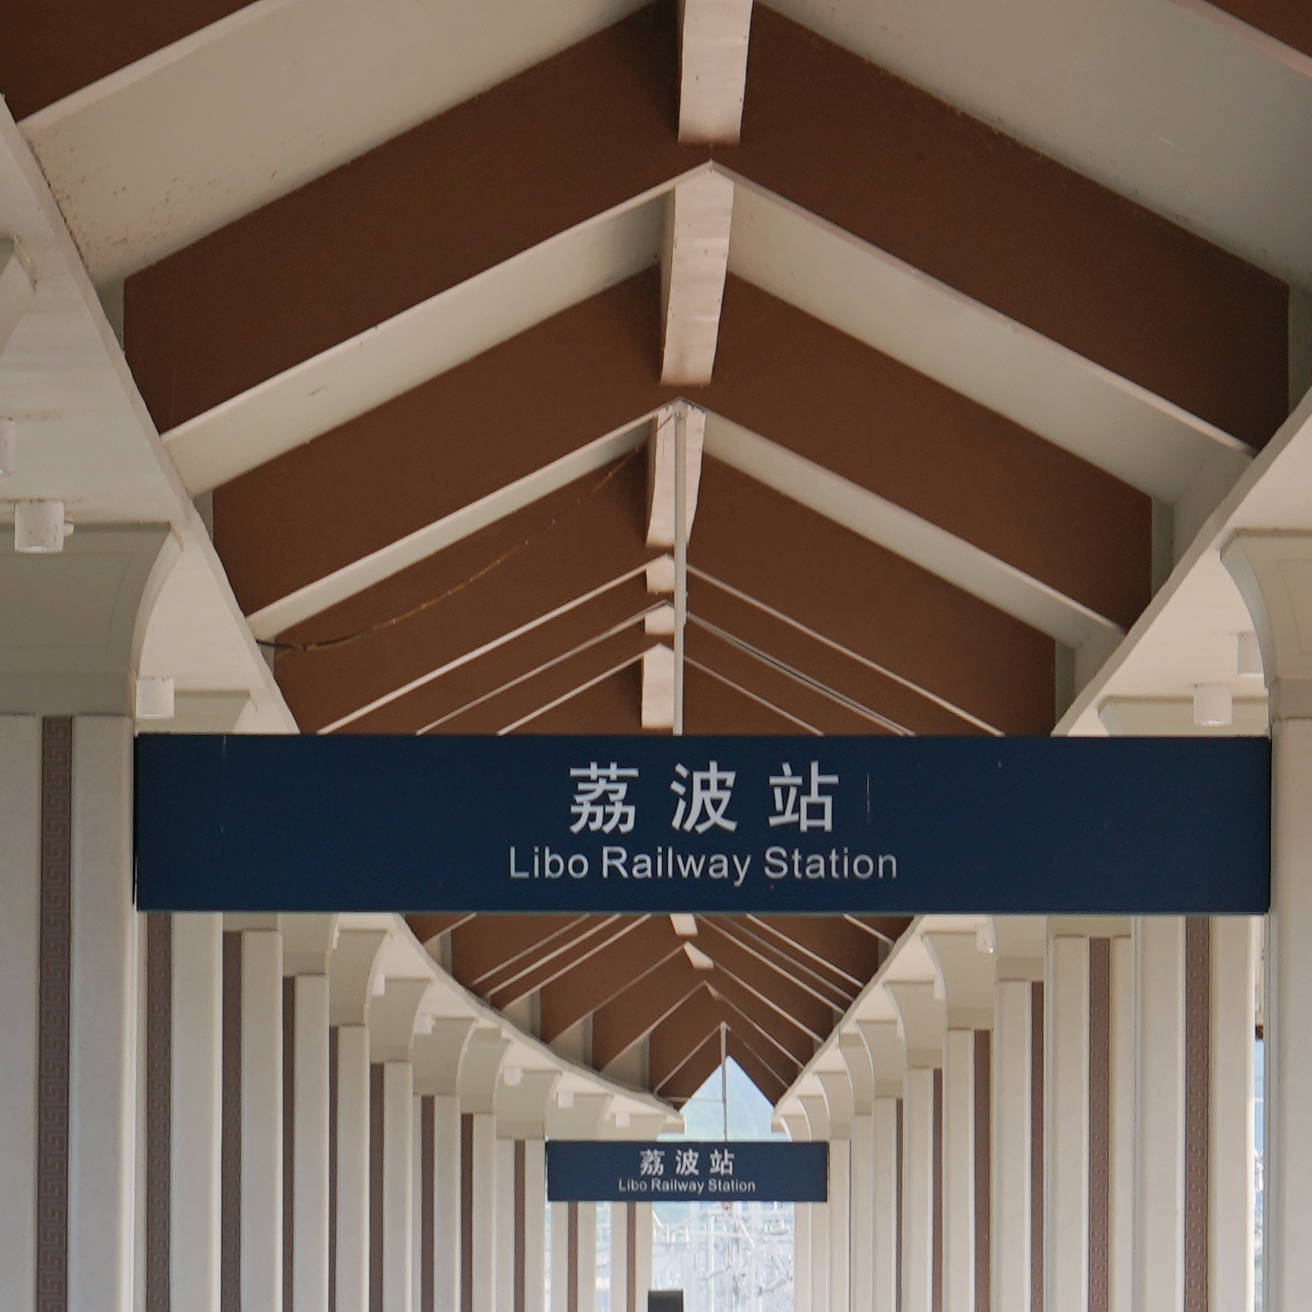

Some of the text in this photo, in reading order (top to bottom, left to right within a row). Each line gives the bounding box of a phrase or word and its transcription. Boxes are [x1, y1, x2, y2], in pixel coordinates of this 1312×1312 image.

[569, 760, 840, 834] 荔波站
[509, 846, 898, 887] Libo Railway Station
[639, 1148, 735, 1176] 荔波站
[618, 1177, 756, 1194] Libo Railway Station
